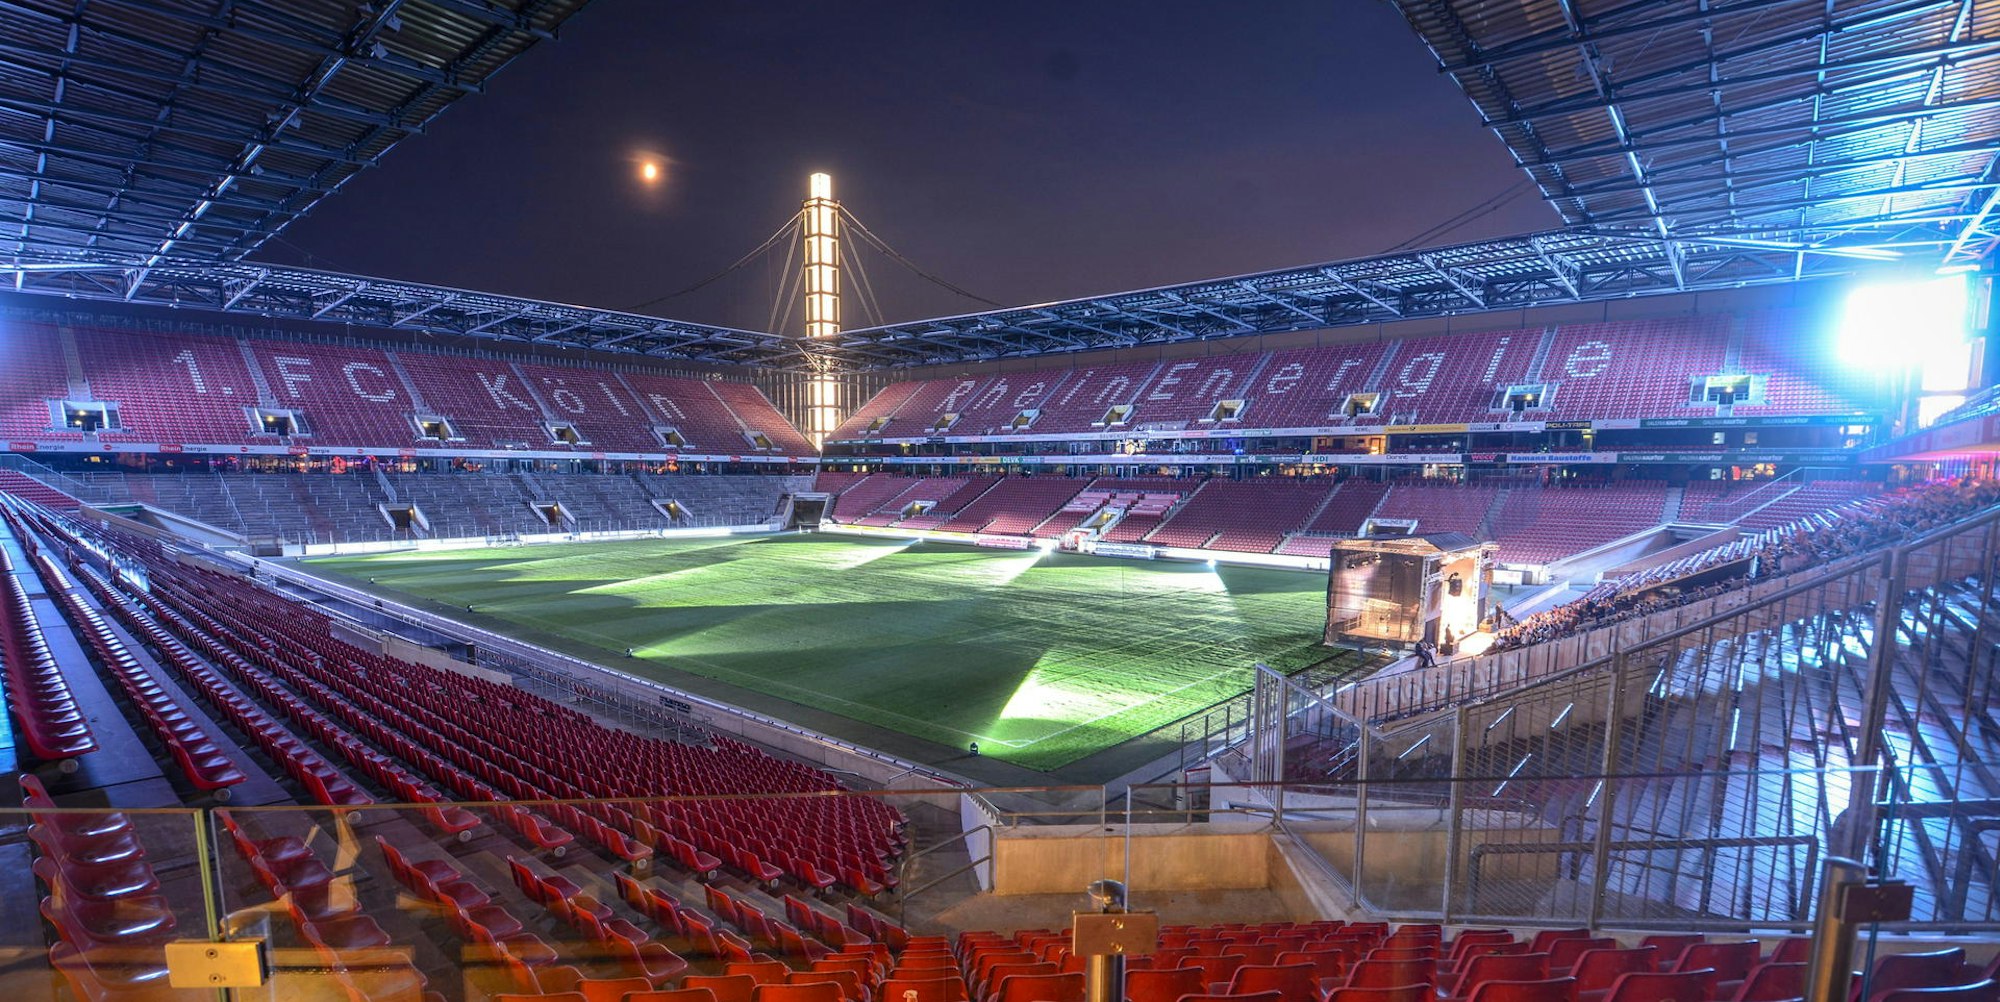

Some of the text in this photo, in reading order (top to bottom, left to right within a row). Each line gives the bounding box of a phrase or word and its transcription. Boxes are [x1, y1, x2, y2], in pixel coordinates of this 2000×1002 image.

[172, 348, 687, 420] 1. FC Köln
